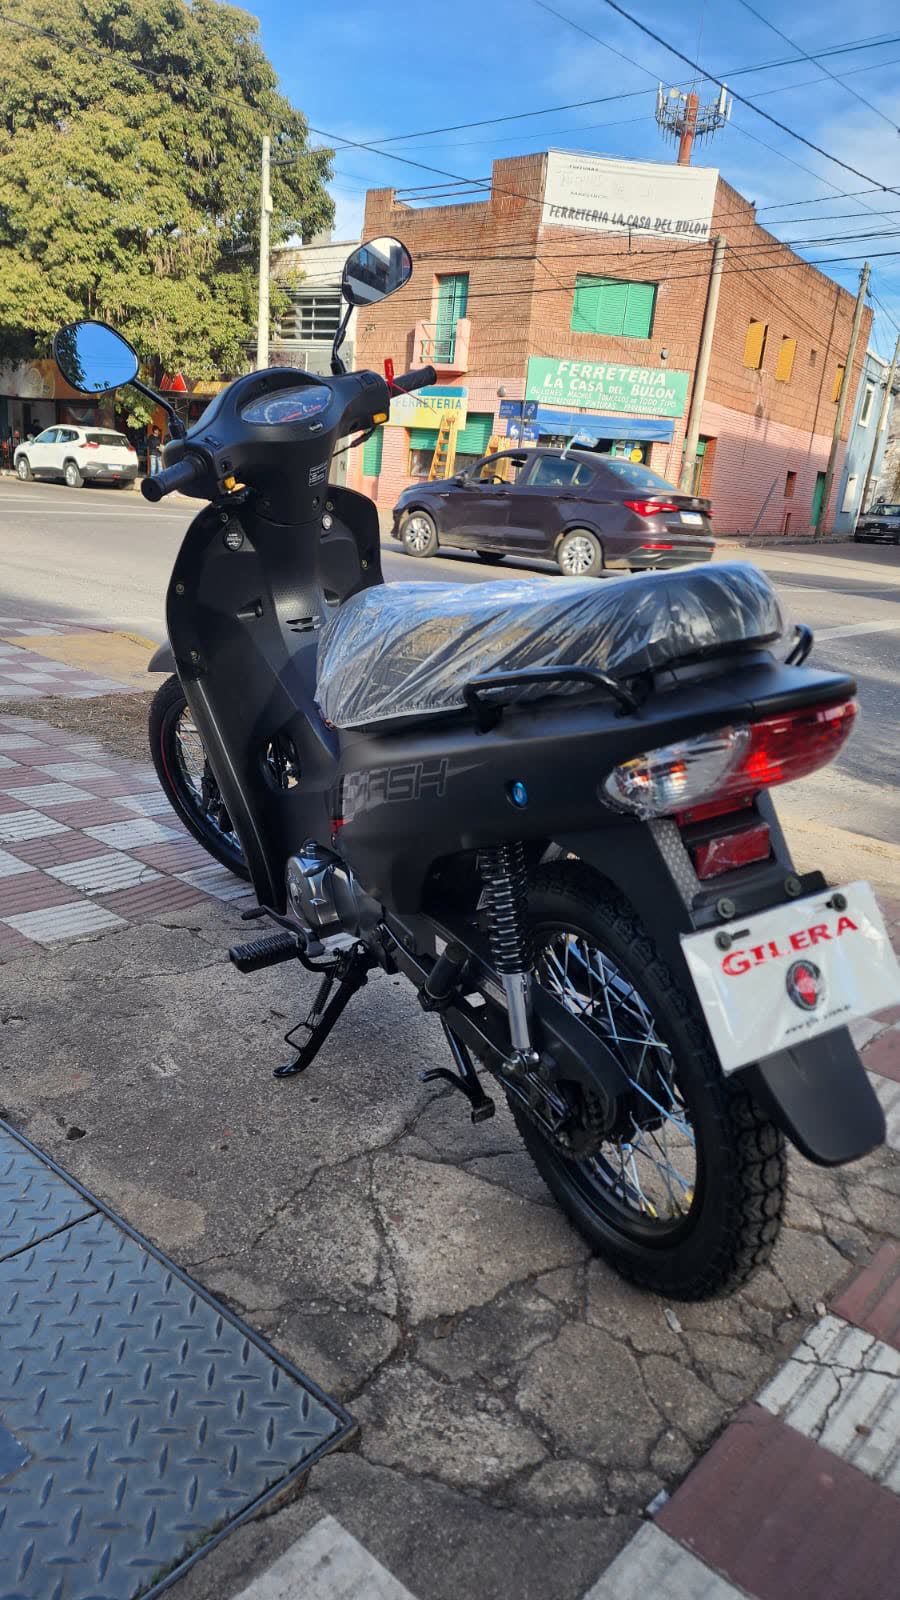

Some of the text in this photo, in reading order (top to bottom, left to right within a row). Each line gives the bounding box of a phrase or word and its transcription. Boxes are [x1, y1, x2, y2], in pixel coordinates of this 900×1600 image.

[549, 205, 708, 236] FERRETERIA LA CASA DEL BULON
[543, 373, 675, 399] LA CASA DEL BULON
[557, 361, 666, 386] FERRETERIA
[394, 398, 462, 409] FERRETERIA
[721, 916, 859, 977] GILERA
